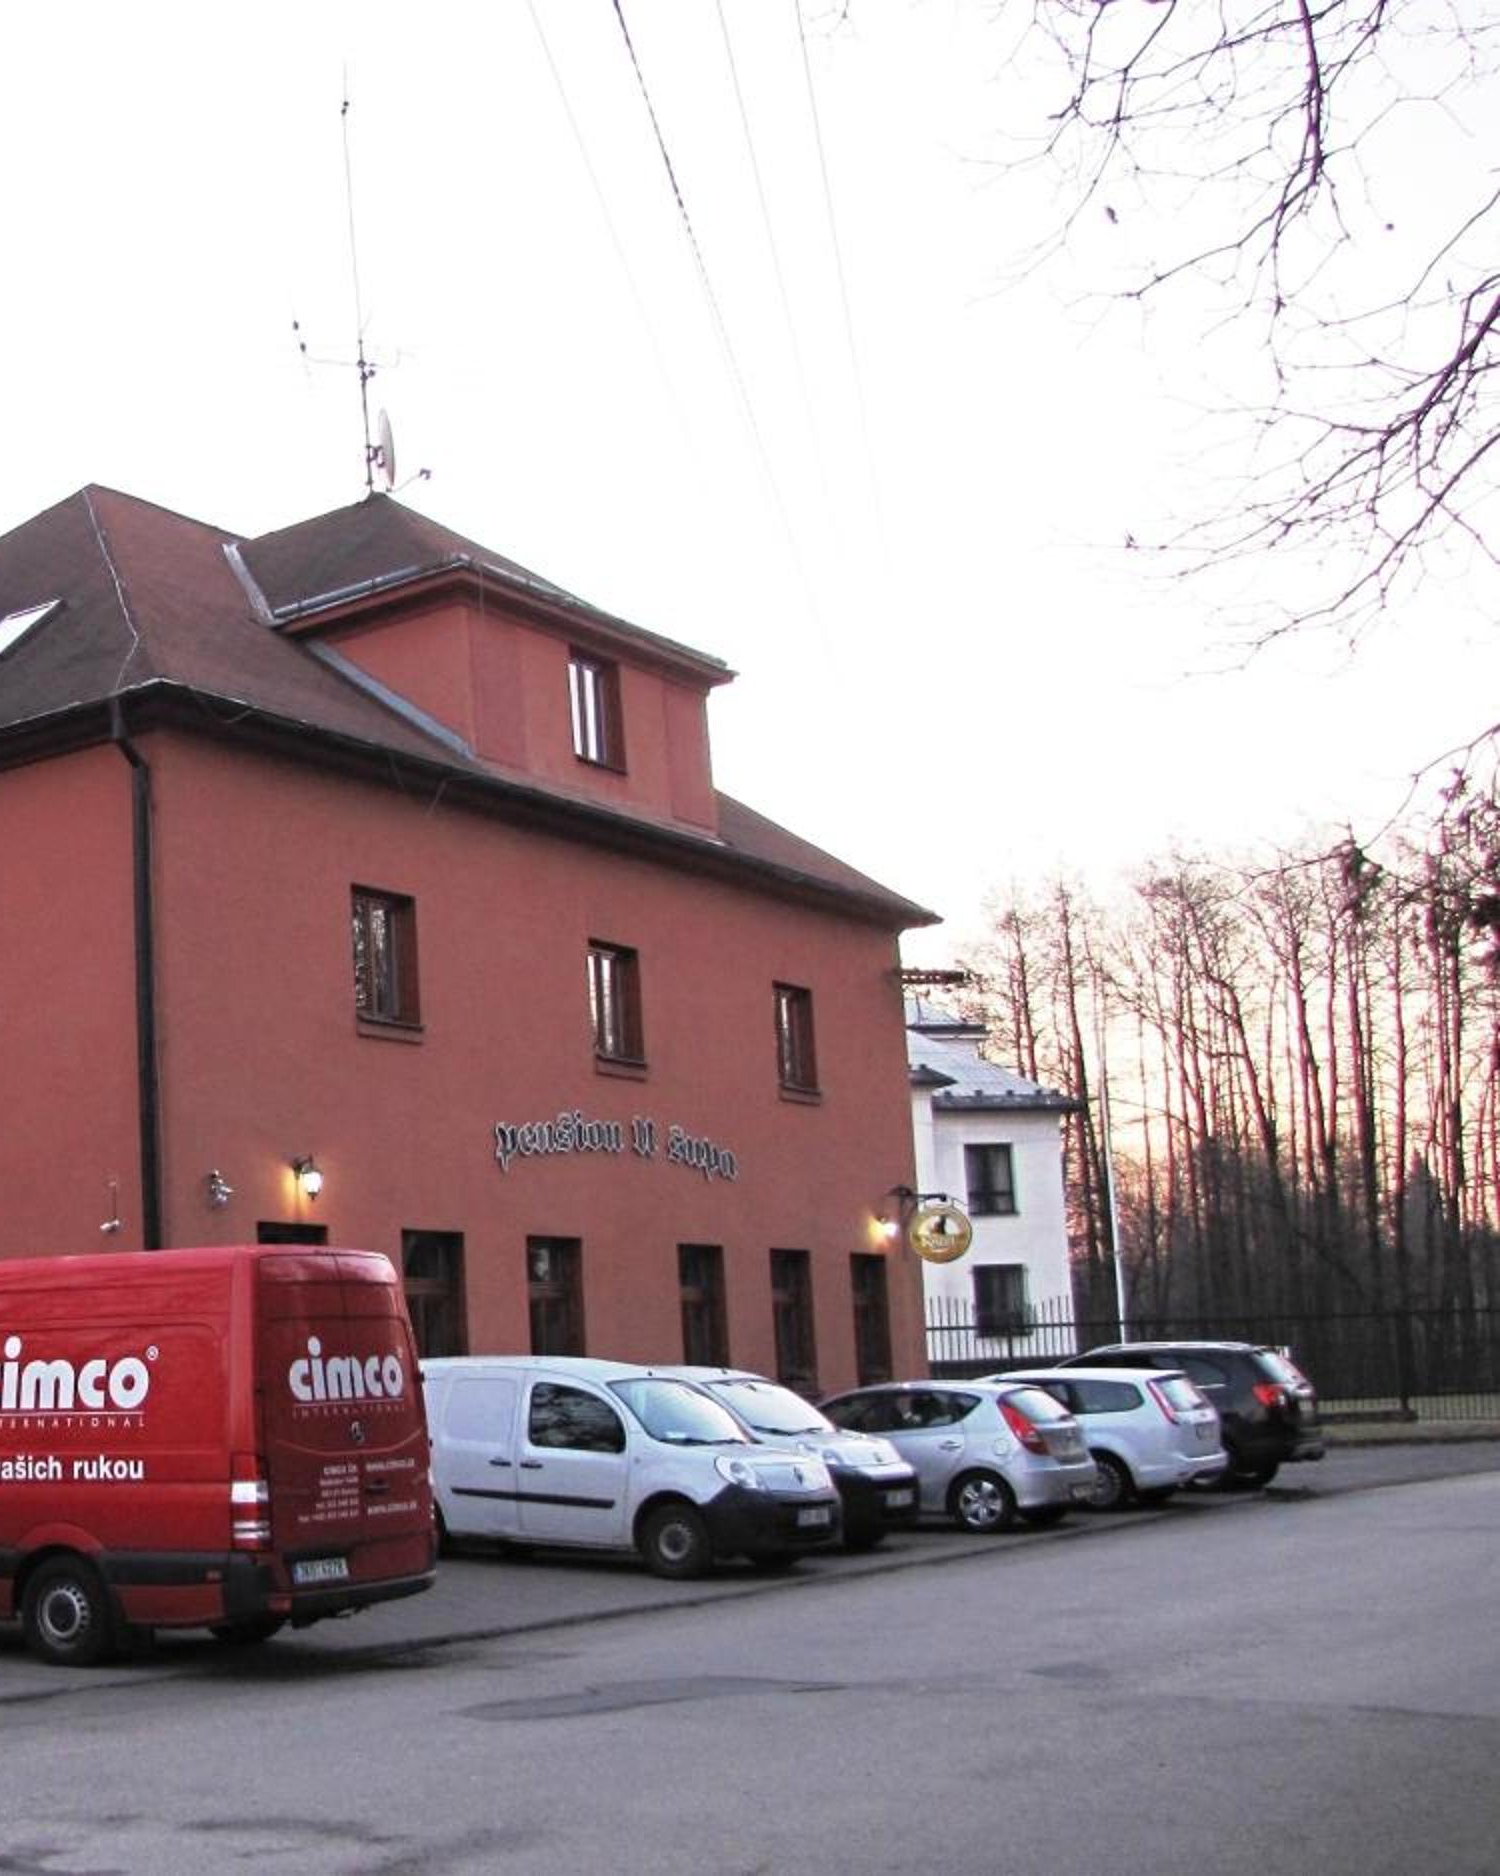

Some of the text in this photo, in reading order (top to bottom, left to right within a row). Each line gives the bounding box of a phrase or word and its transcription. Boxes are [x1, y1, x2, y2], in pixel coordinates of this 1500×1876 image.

[495, 1110, 623, 1174] pension
[289, 1335, 403, 1401] cimco
[73, 1454, 145, 1480] rukou
